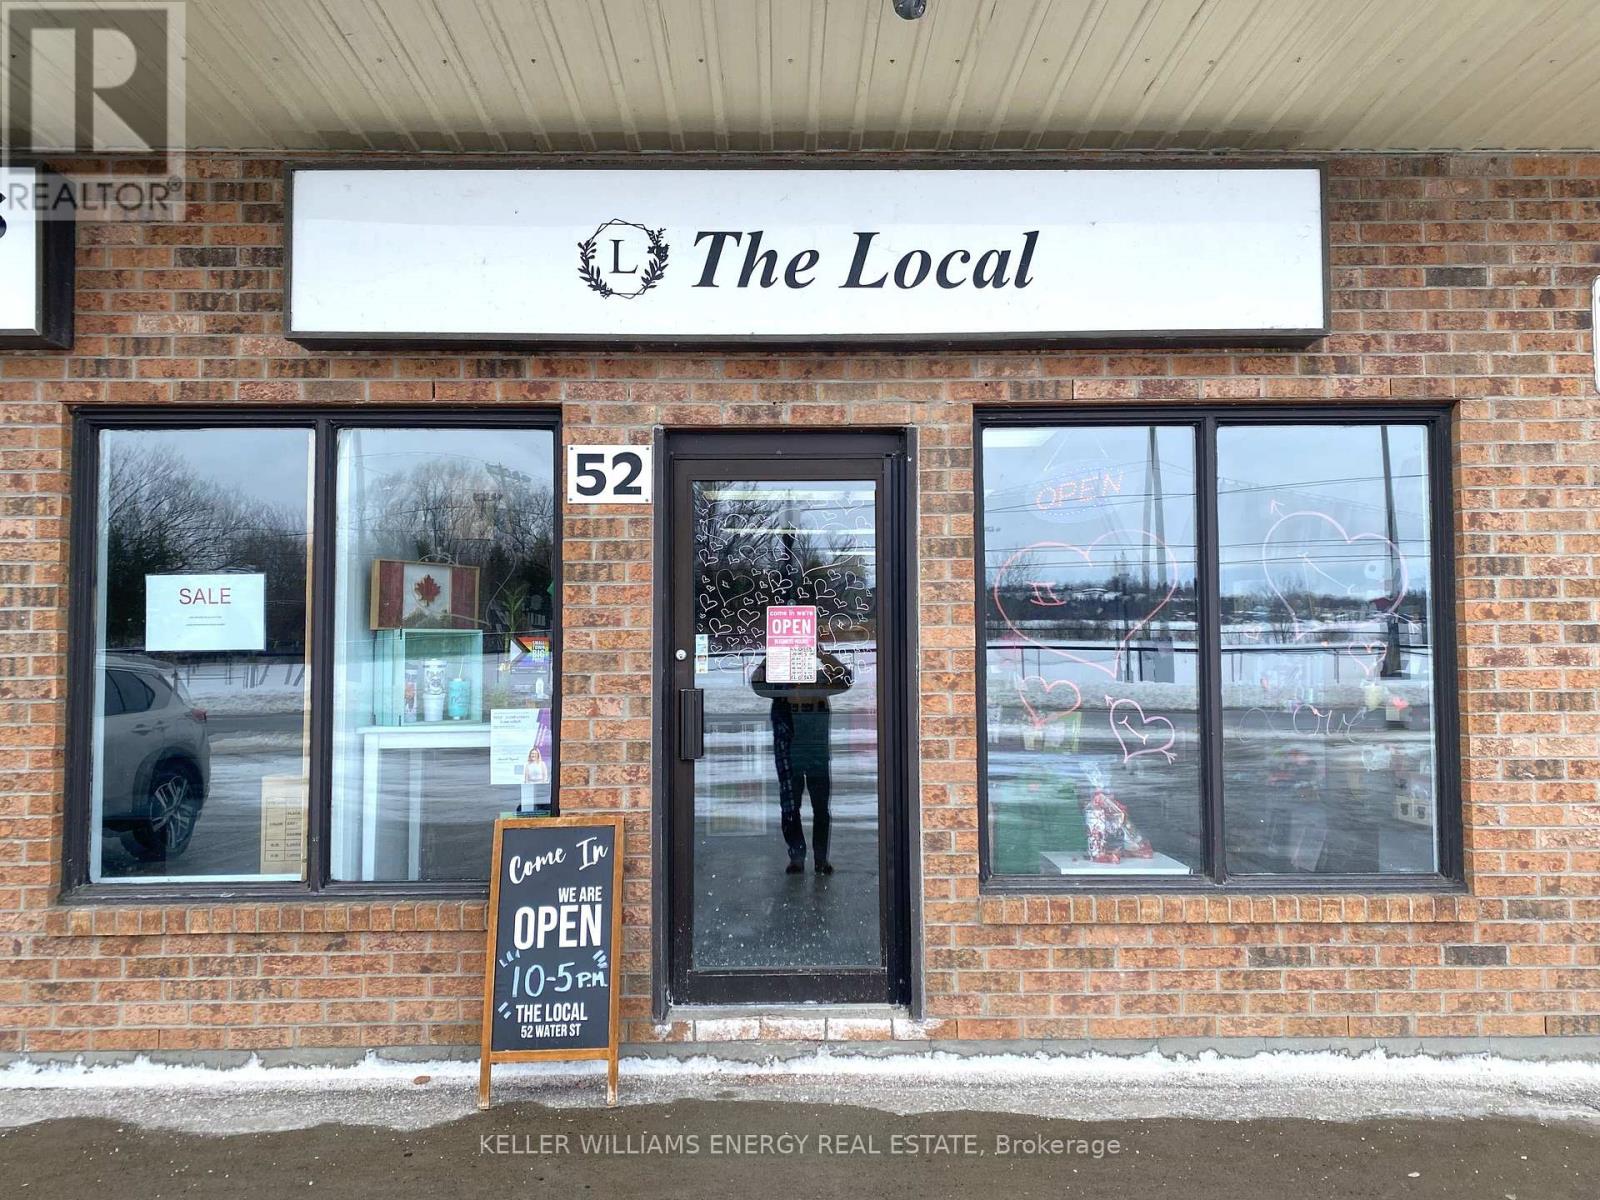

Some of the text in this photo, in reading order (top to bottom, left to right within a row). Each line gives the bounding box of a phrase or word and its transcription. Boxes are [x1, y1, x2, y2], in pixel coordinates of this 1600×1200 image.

[609, 239, 638, 274] L
[692, 230, 1040, 289] The Local
[576, 452, 642, 496] 52
[1035, 473, 1124, 509] OPEN
[179, 587, 232, 605] SALE
[772, 618, 811, 634] OPEN
[509, 836, 608, 884] Come In
[558, 886, 603, 902] WE ARE
[513, 904, 602, 950] OPEN
[512, 962, 575, 997] 10-5
[516, 1002, 588, 1023] THE LOCAL
[521, 1024, 581, 1038] 52 WATER ST
